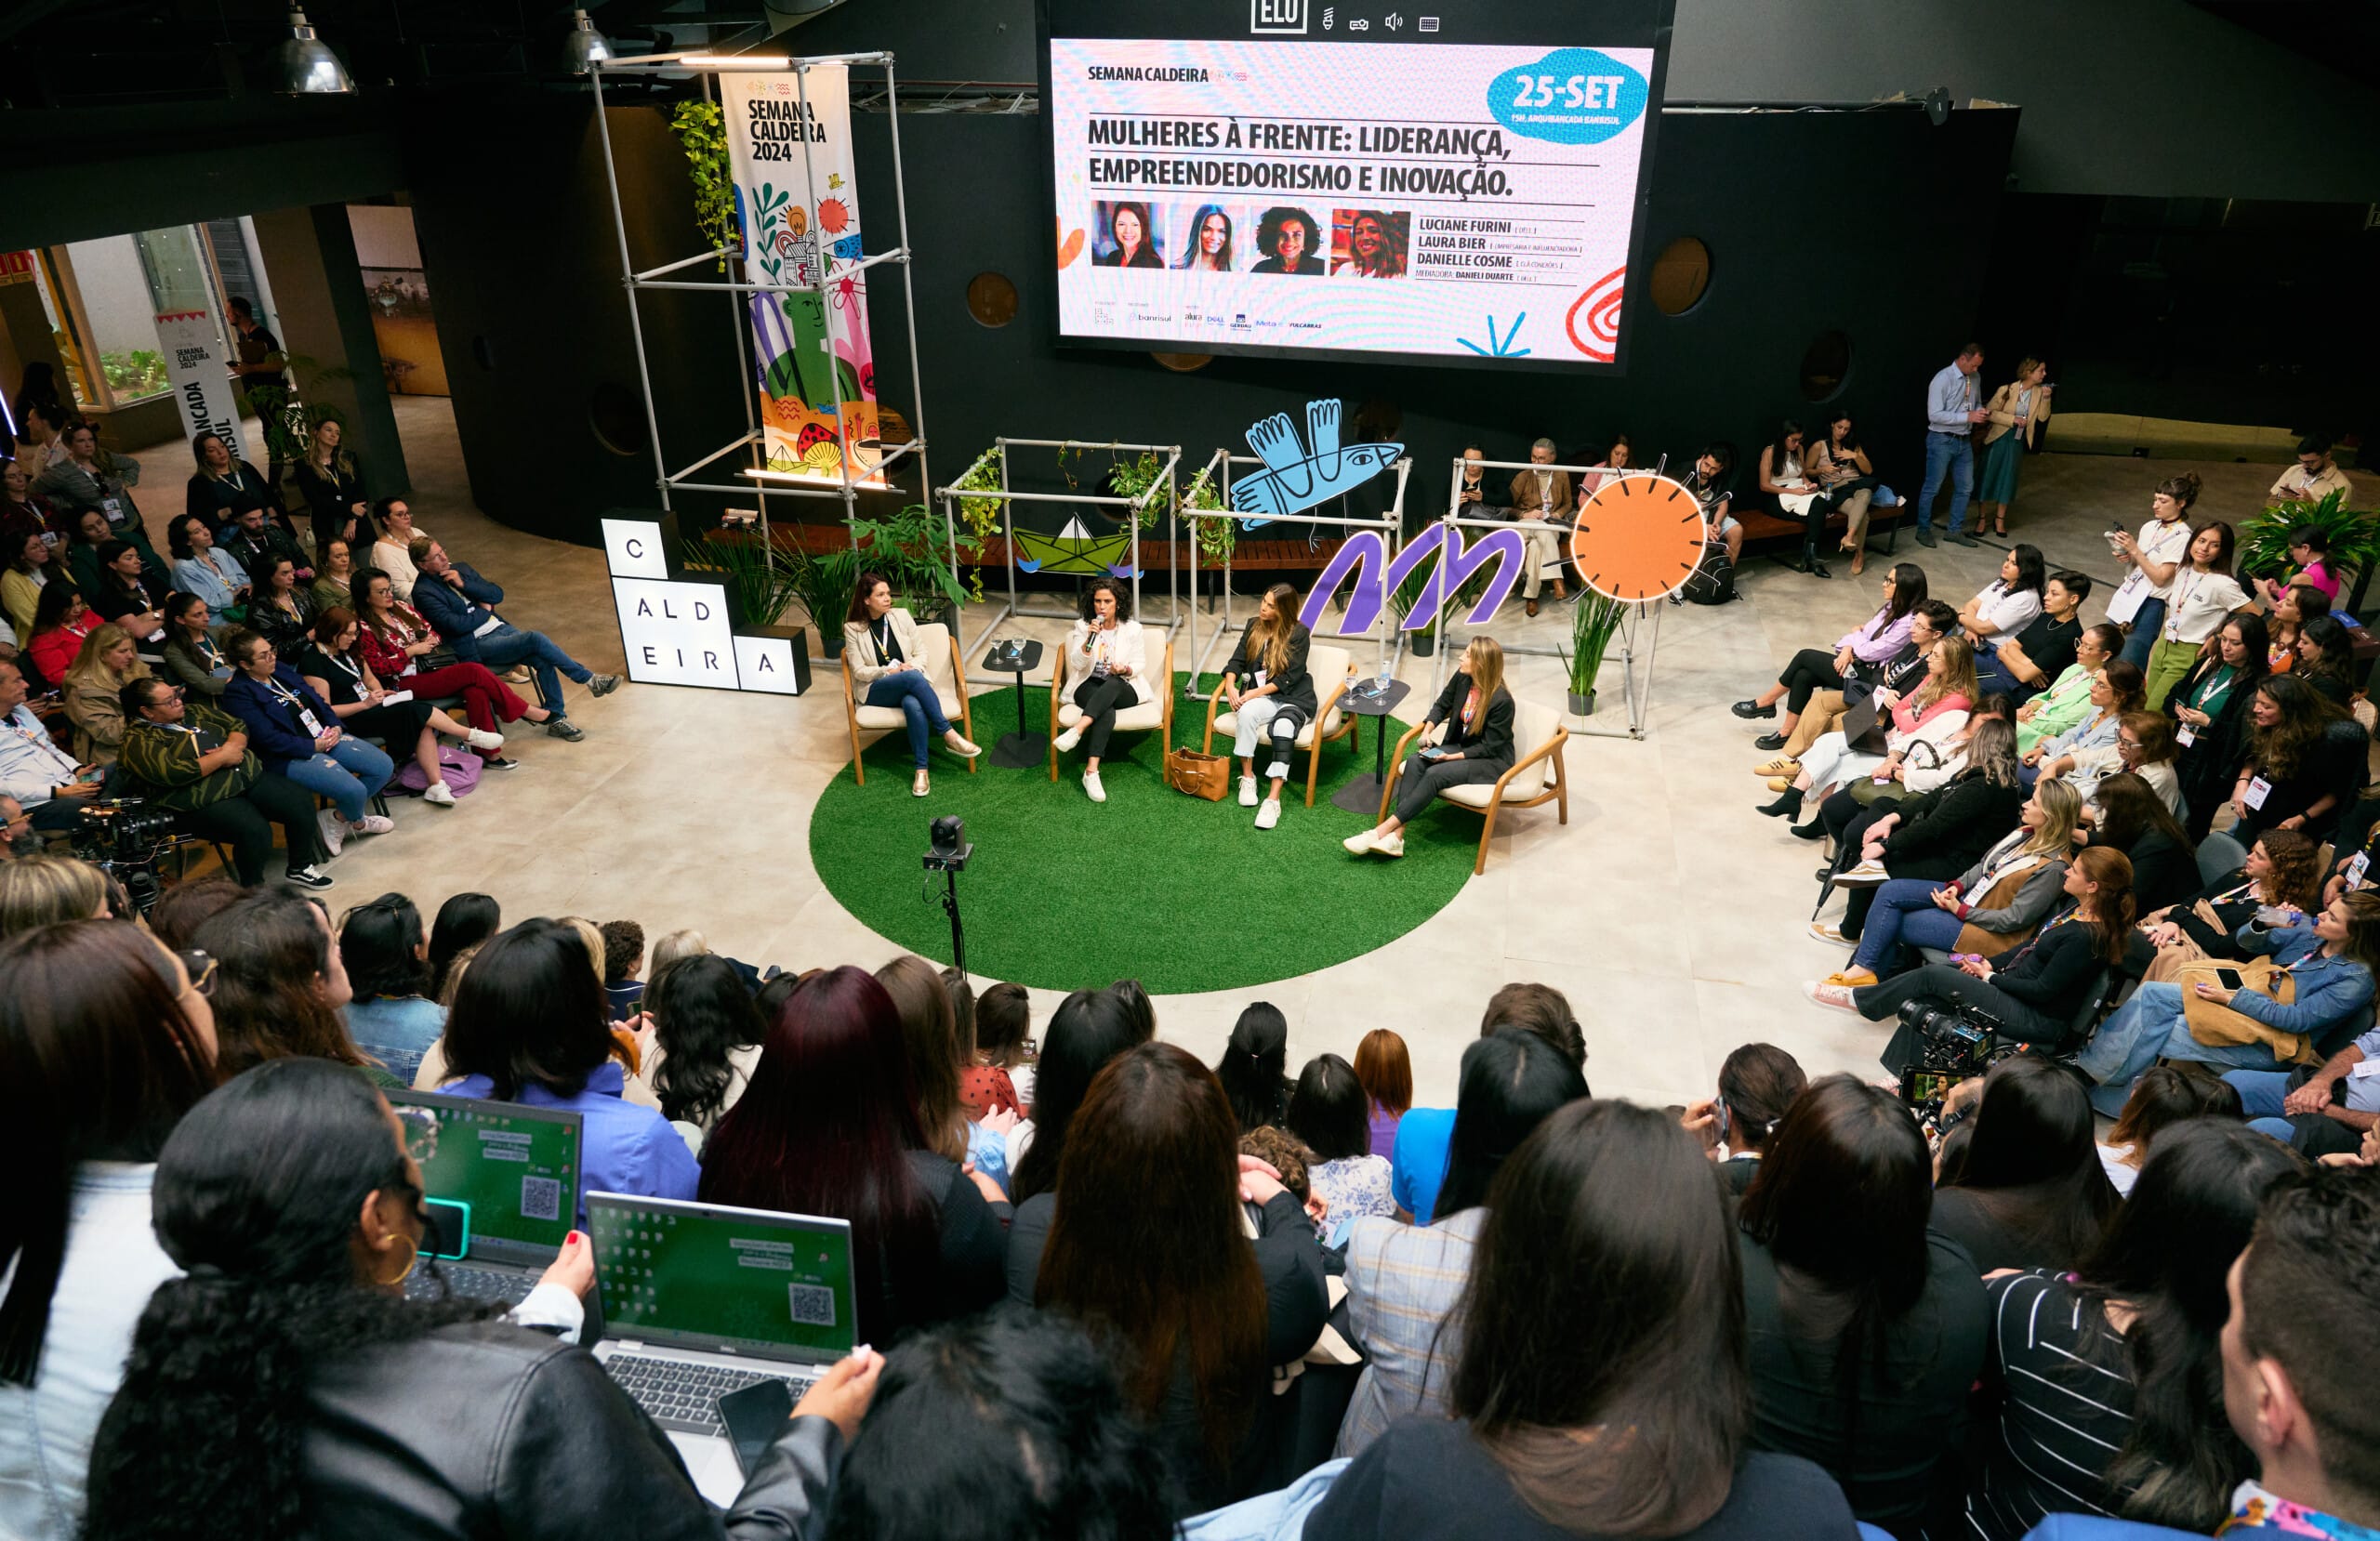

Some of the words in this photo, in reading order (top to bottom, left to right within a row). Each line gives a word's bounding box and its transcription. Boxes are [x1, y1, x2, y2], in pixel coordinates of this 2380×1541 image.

[1089, 67, 1143, 81] SEMANA
[1144, 68, 1209, 82] CALDEIRA
[1513, 74, 1624, 109] 25-SET
[748, 99, 815, 122] SEMANA
[1089, 119, 1219, 148] MULHERES
[1225, 116, 1242, 149] À
[1249, 123, 1352, 151] FRENTE:
[1359, 126, 1511, 163] LIDERANÇA,
[752, 141, 792, 162] 2024
[1090, 157, 1352, 191] EMPREENDEDORISMO
[1358, 165, 1372, 191] E
[1380, 163, 1513, 201] INOVAÇÃO.
[1420, 218, 1468, 232] LUCIANE
[1470, 220, 1512, 233] FURINI
[1418, 236, 1457, 249] LAURA
[1458, 237, 1487, 249] BIER
[1417, 253, 1472, 267] DANIELLE
[1474, 255, 1513, 268] COSME
[1455, 271, 1484, 280] DANIELI
[1485, 272, 1514, 281] DUARTE
[176, 347, 205, 357] SEMANA
[178, 352, 211, 362] CALDEIRA
[626, 538, 643, 559] C
